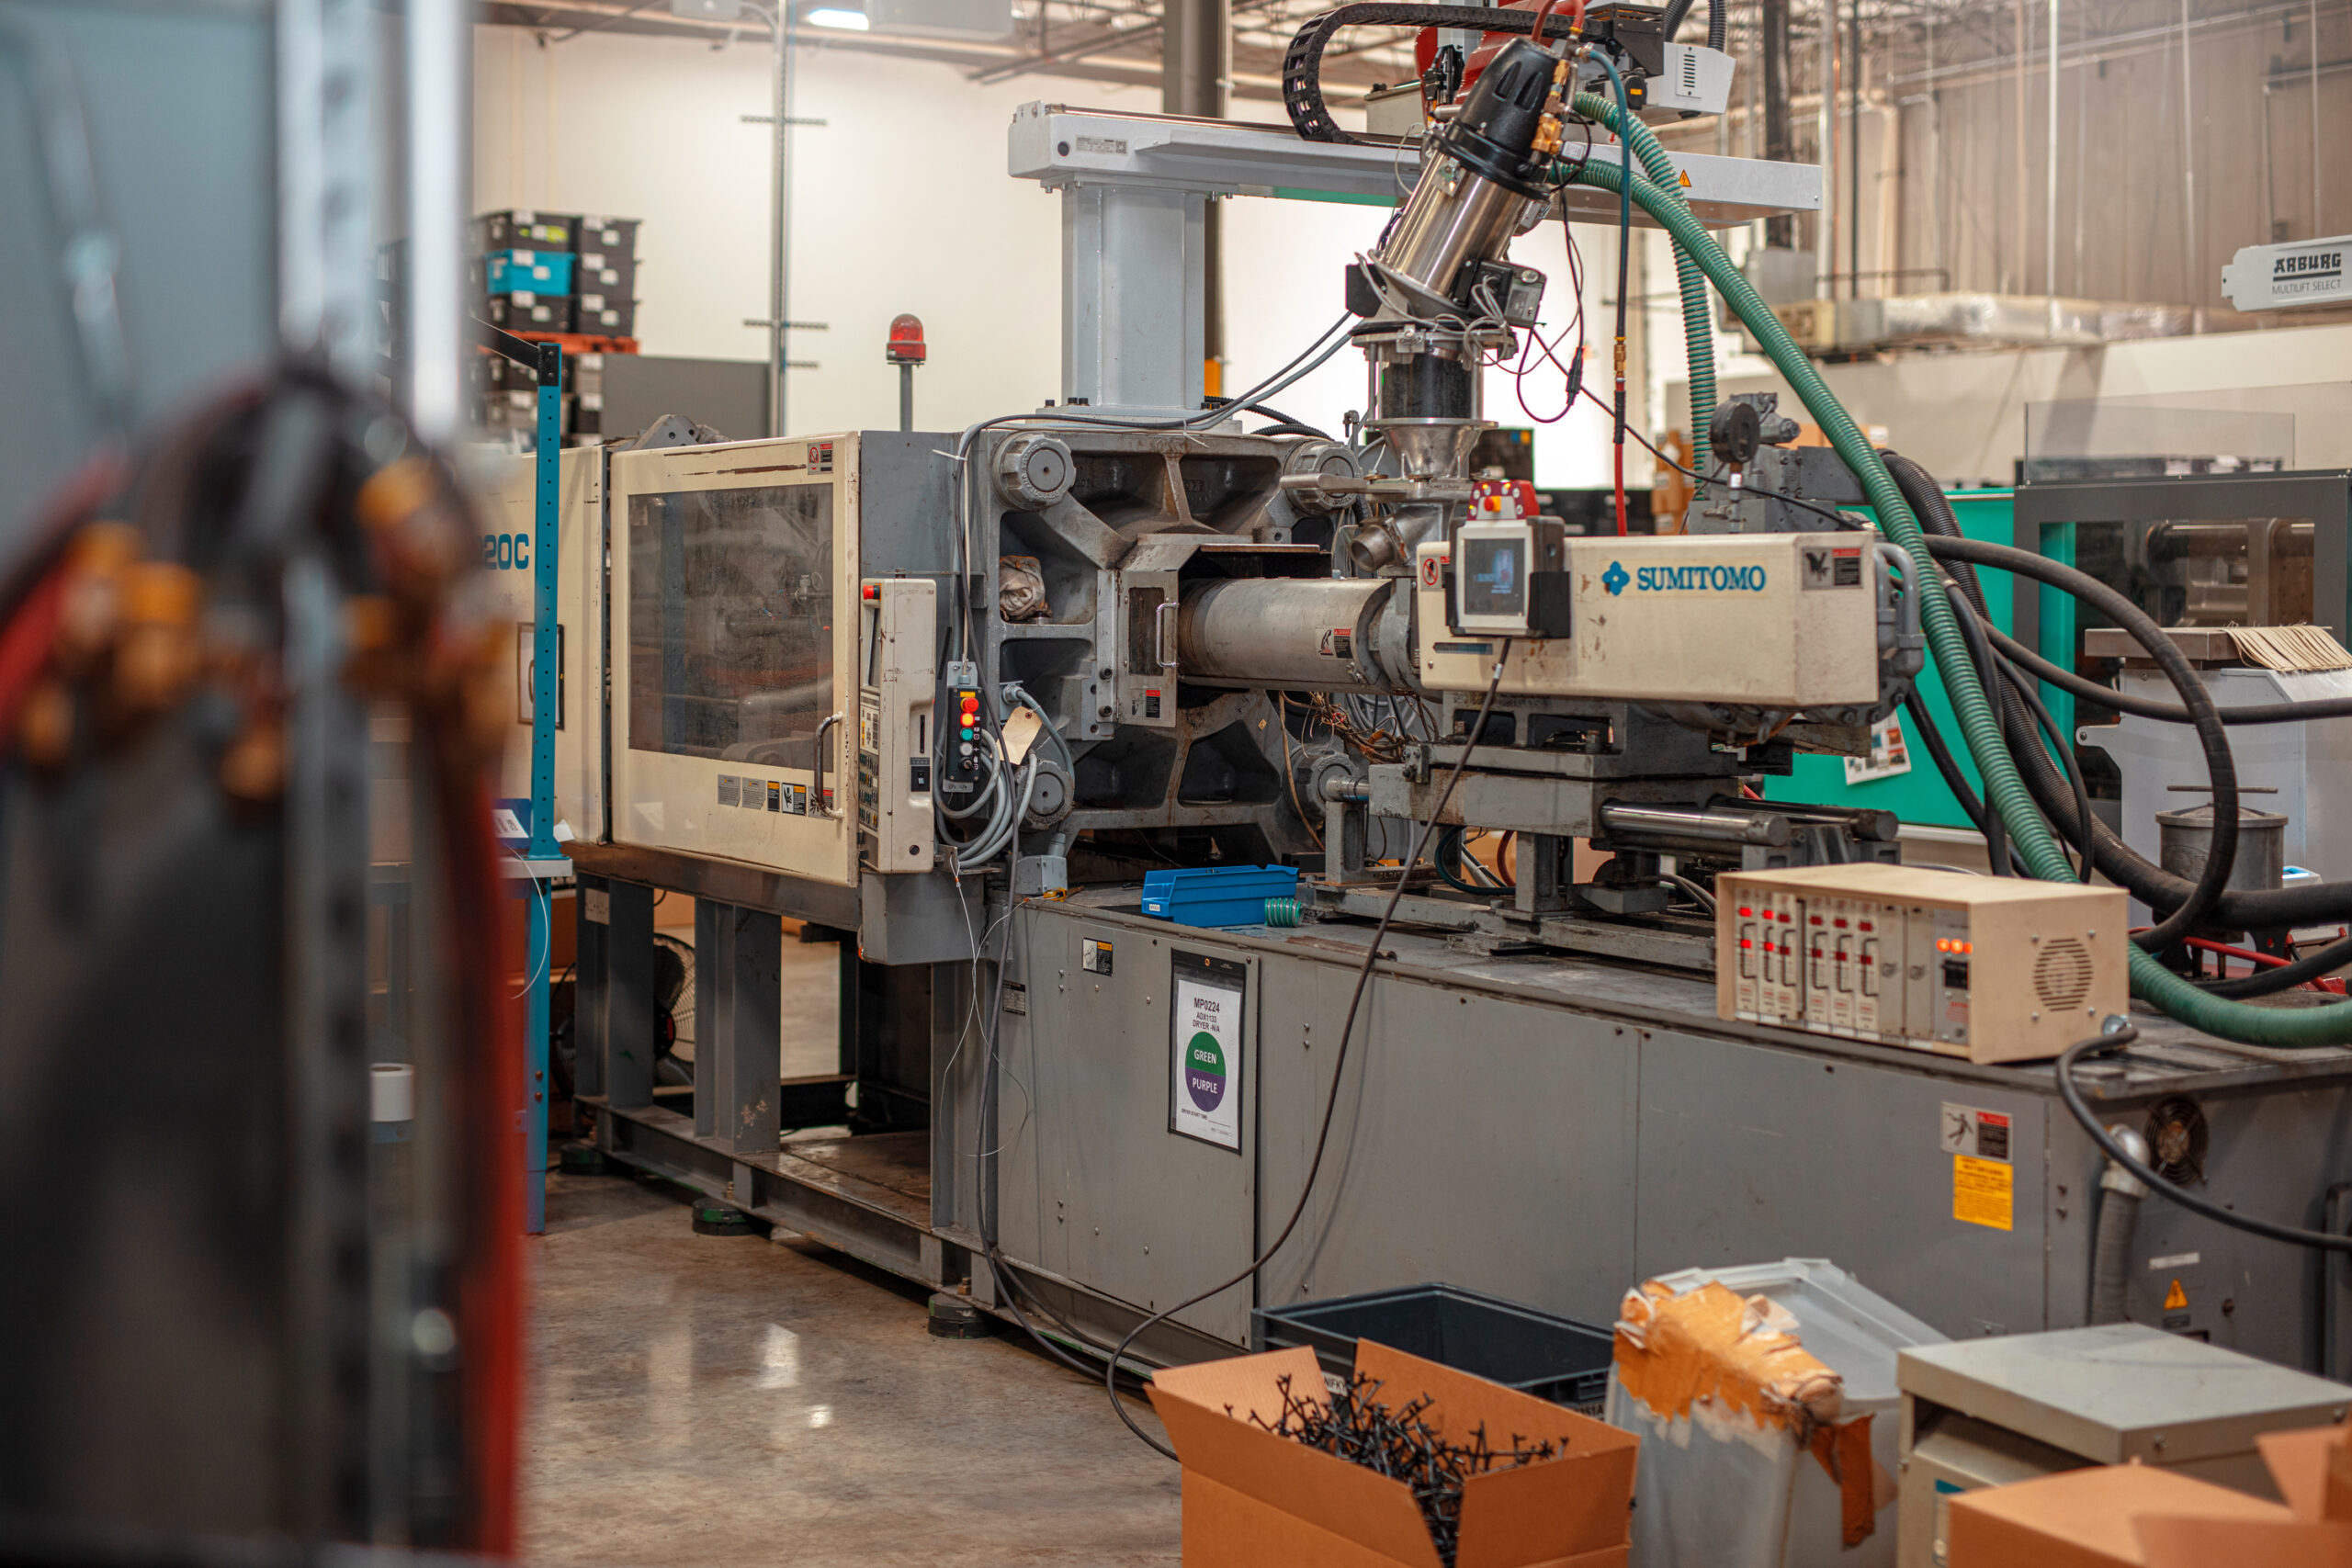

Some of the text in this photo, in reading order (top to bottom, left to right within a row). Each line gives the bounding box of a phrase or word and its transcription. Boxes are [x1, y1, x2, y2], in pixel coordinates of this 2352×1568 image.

[2273, 253, 2342, 274] ARBURG
[2272, 279, 2342, 295] MULTILIFT SELECT
[478, 533, 530, 570] 20C
[1637, 565, 1767, 592] SUMITOMO
[1193, 998, 1220, 1013] MP0224
[1193, 1049, 1217, 1065] GREEN
[1193, 1077, 1218, 1094] PURPLE
